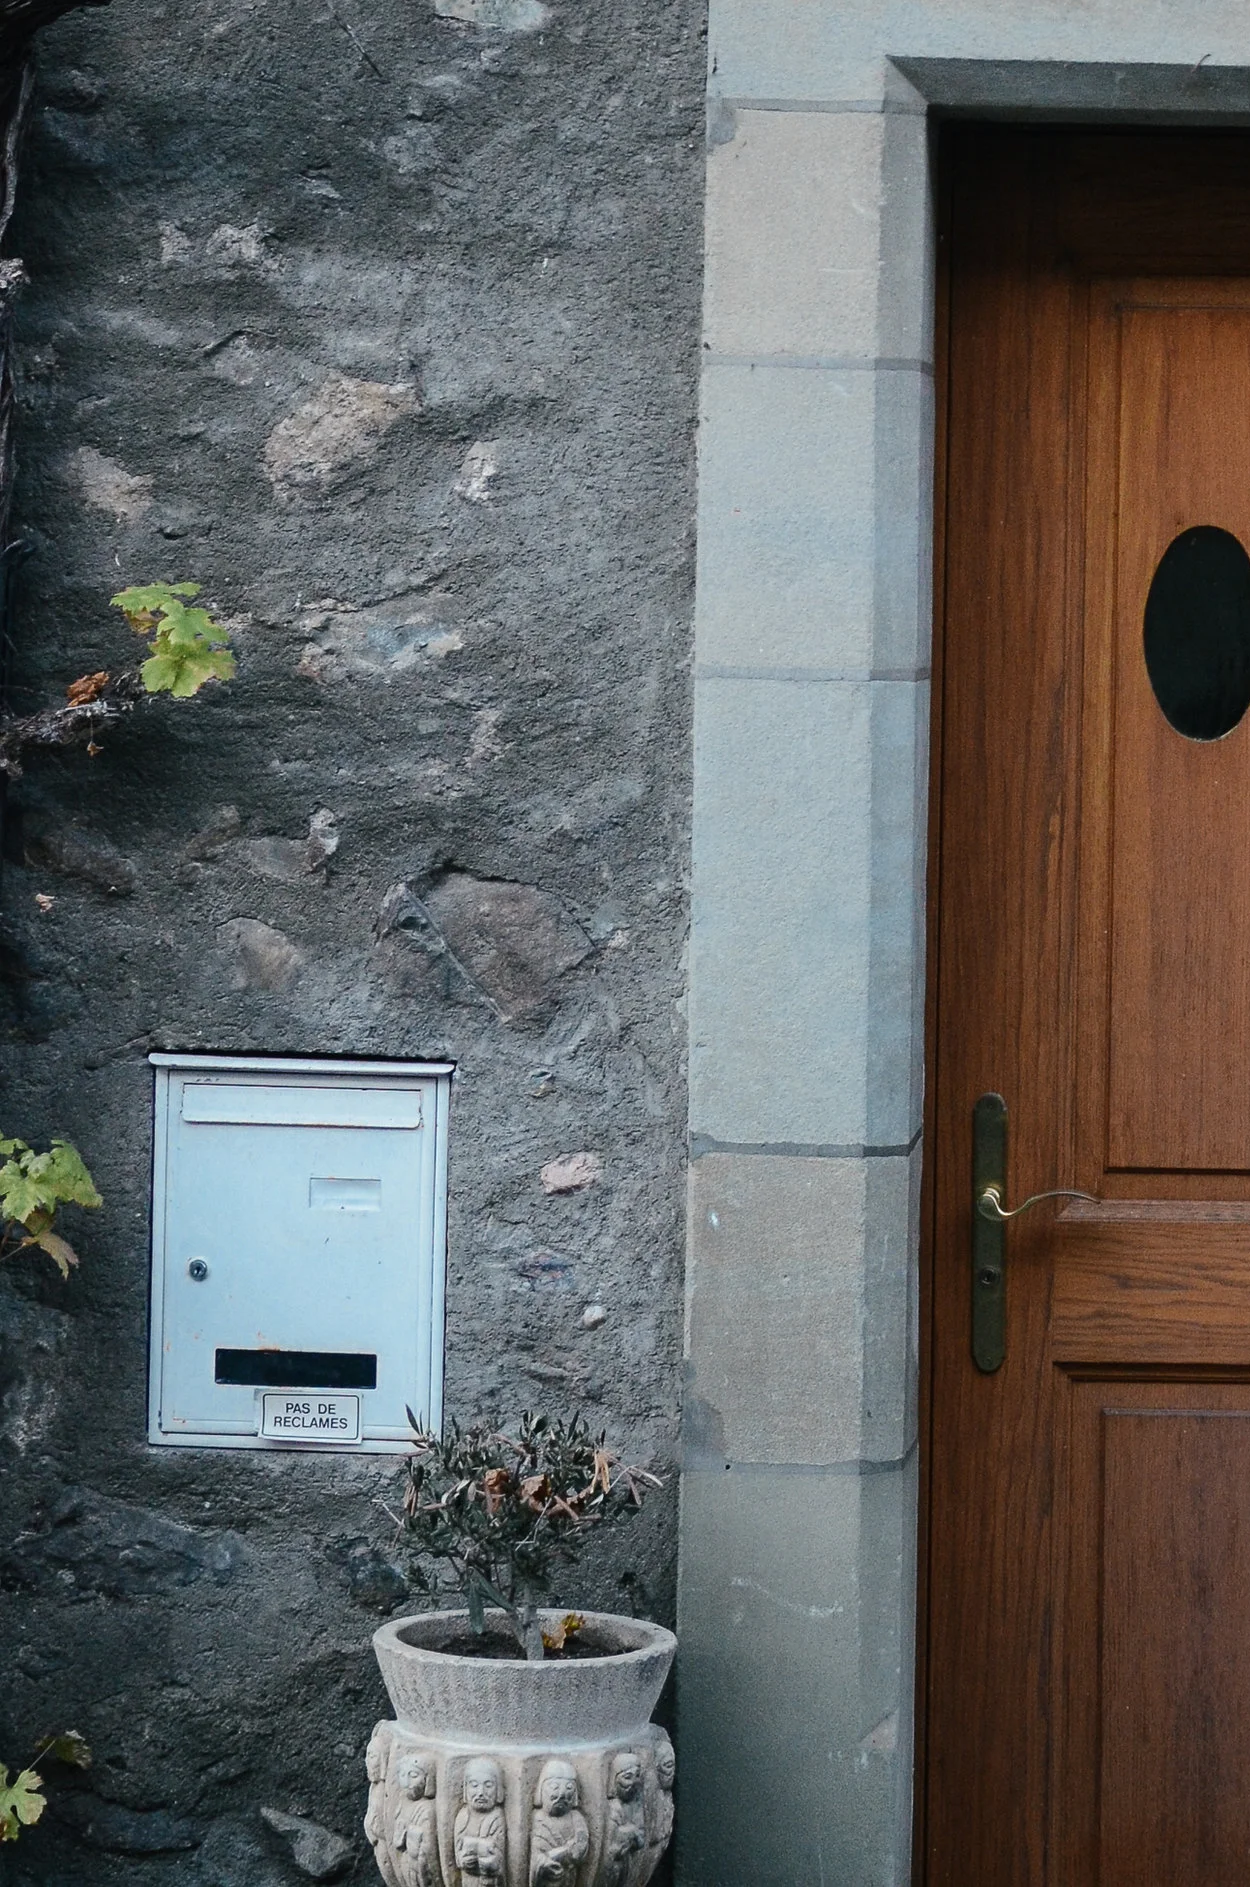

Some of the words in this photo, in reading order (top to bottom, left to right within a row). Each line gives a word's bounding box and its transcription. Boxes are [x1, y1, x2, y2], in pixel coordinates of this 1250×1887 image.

[286, 1403, 311, 1414] PAS
[318, 1404, 336, 1414] DE
[274, 1416, 348, 1429] RECLAMES
